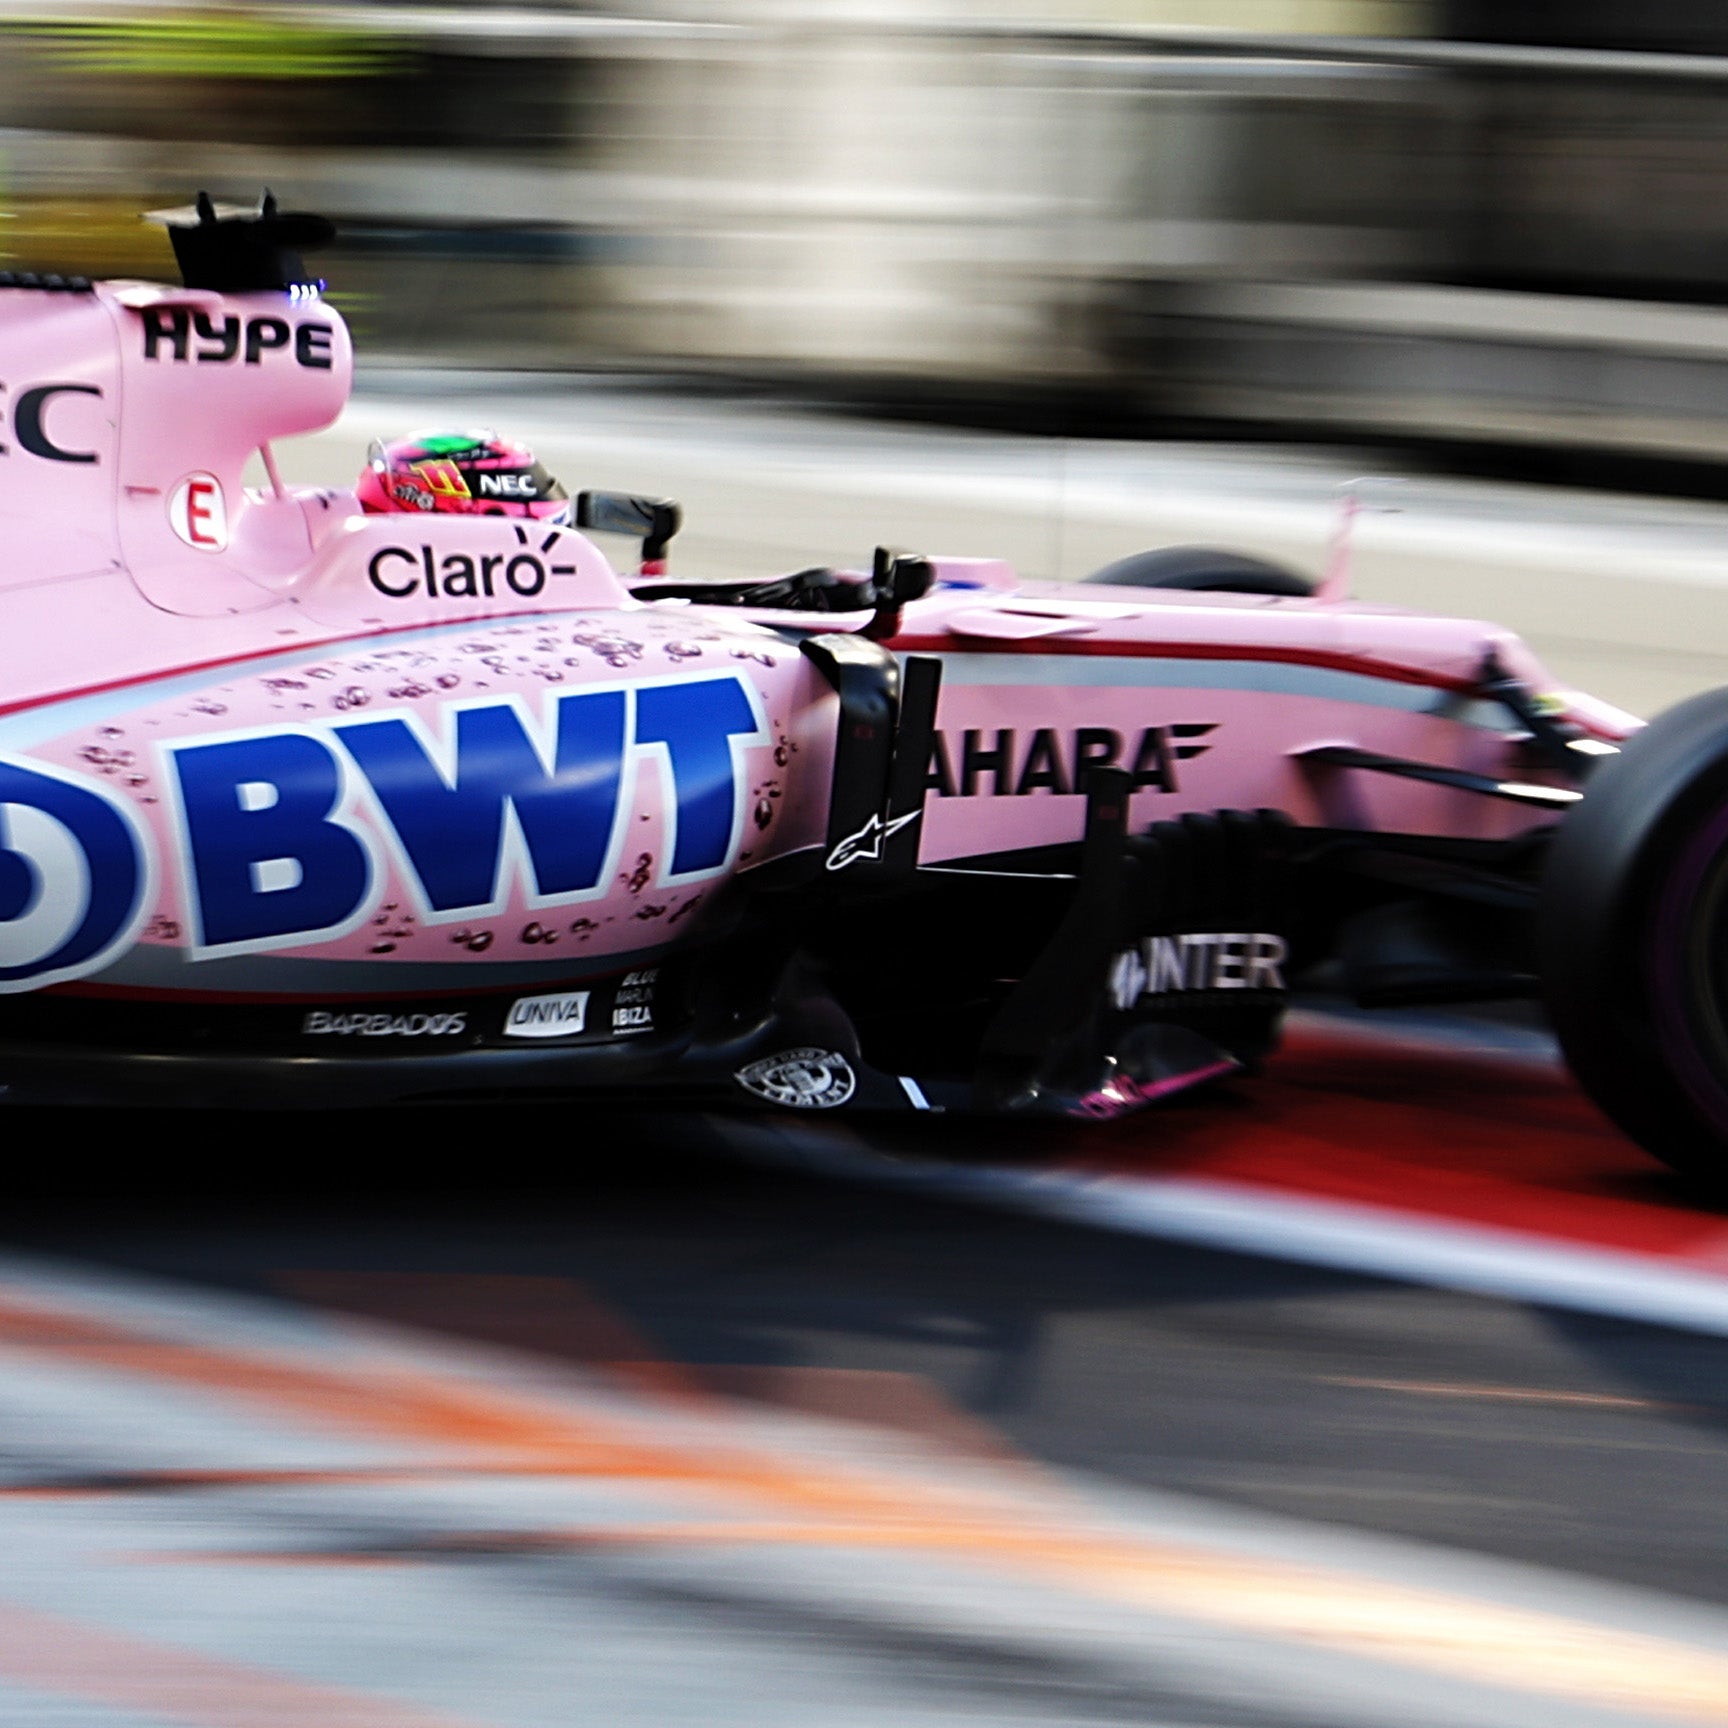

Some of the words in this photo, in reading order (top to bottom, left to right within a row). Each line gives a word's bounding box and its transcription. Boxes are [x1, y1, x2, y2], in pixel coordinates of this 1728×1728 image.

[143, 308, 334, 369] HYPE
[480, 474, 537, 496] NEC
[368, 542, 550, 598] Claro
[922, 727, 1184, 799] AHARA
[160, 670, 769, 960] BWT
[303, 1011, 468, 1036] BARBADOS
[612, 1006, 653, 1027] IBIZA
